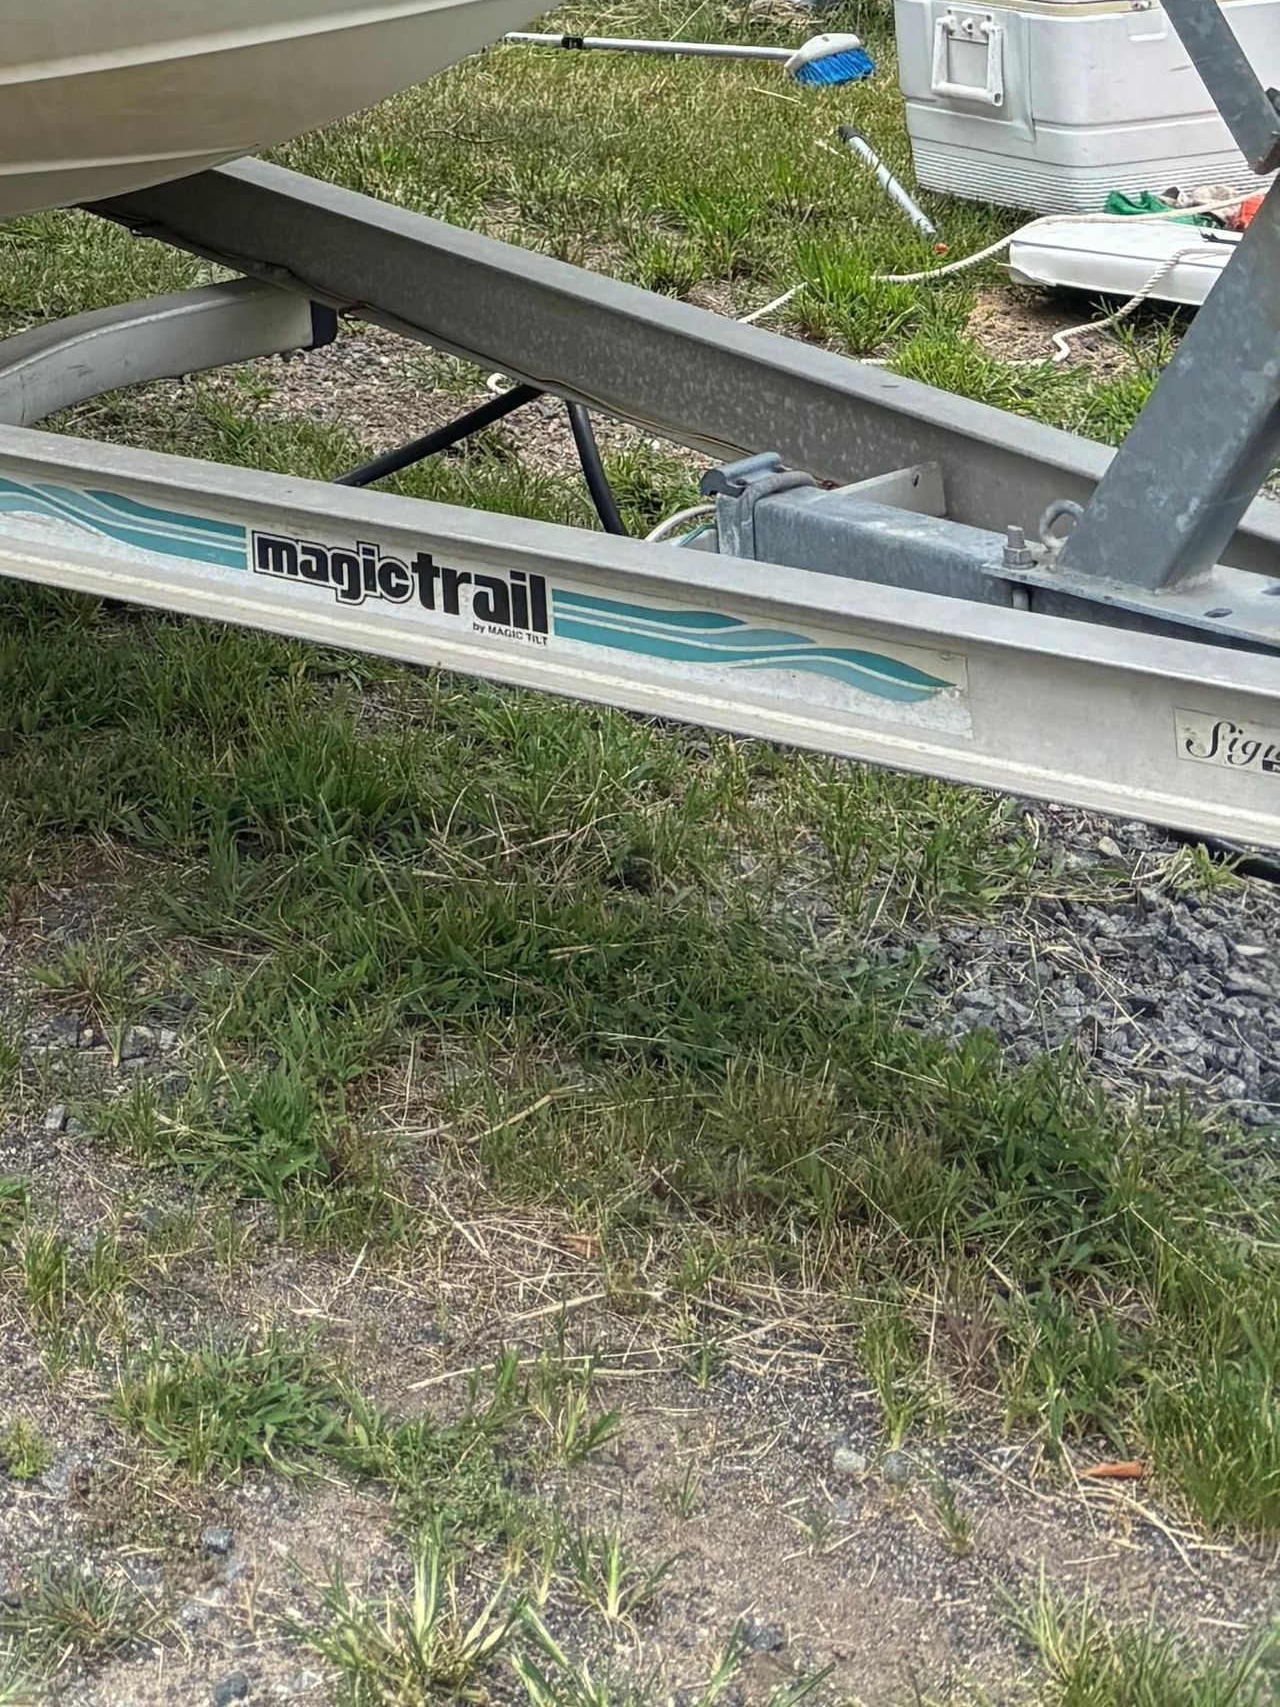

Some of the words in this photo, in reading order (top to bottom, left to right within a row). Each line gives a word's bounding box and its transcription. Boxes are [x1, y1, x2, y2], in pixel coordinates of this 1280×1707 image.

[473, 621, 486, 635] by
[488, 625, 524, 640] MAGIC
[525, 633, 548, 646] TILT
